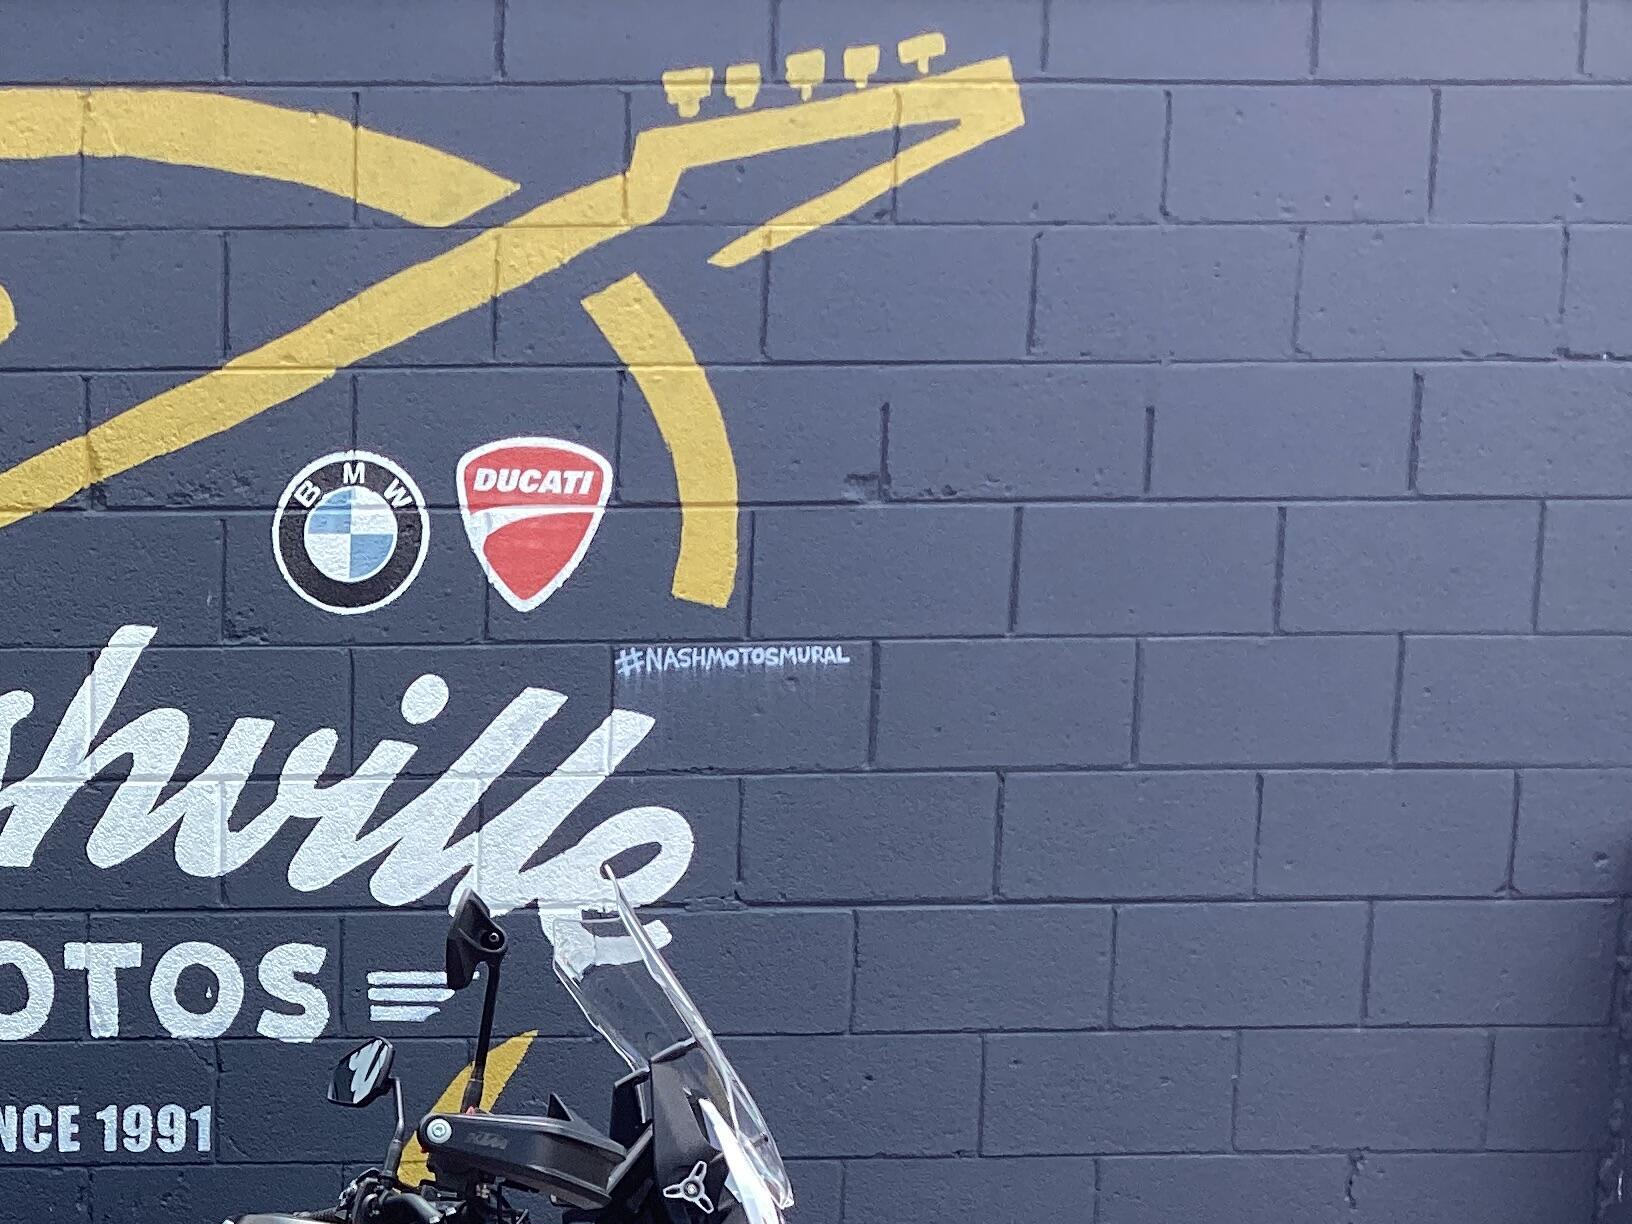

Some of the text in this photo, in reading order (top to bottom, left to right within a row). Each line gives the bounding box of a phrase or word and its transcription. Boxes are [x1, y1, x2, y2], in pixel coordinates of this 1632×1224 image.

[294, 462, 412, 508] BMW
[473, 468, 594, 495] DUCATI
[615, 645, 850, 677] #NASHMOTOSMURAL
[96, 1104, 212, 1152] 1991
